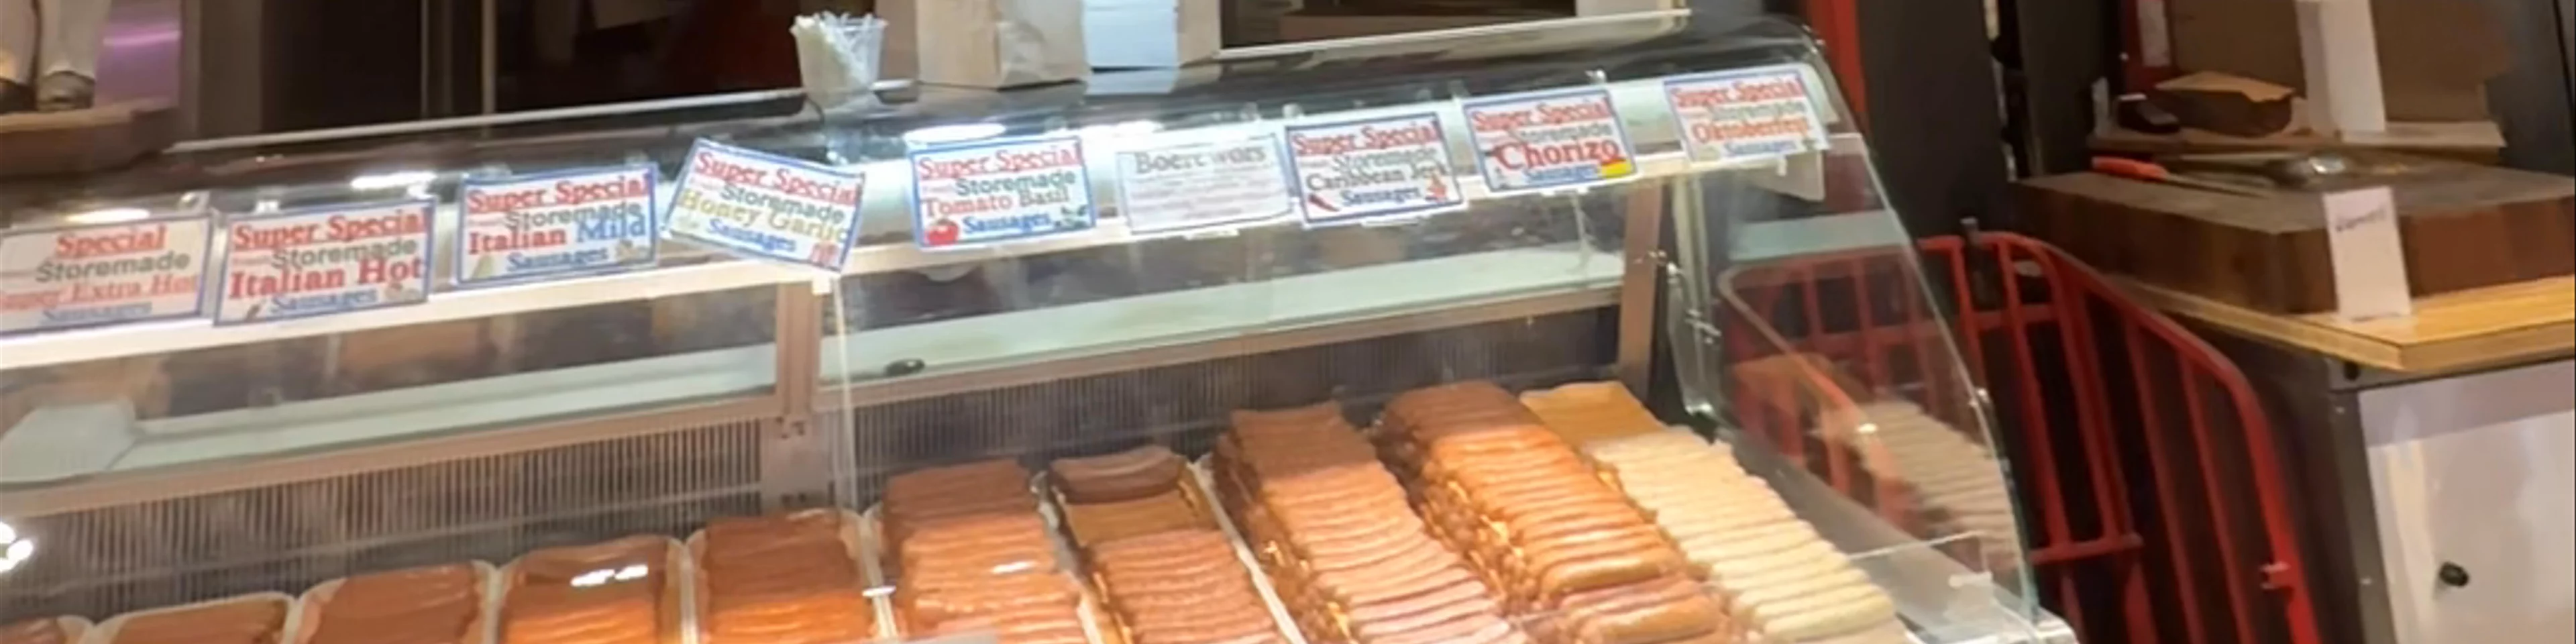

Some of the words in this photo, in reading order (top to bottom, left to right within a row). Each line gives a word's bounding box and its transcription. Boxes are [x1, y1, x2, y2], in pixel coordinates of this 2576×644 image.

[1670, 87, 1733, 109] Super
[1732, 72, 1805, 103] Special
[1470, 111, 1534, 133] Super
[1534, 97, 1611, 126] Special
[1292, 133, 1357, 156] Super
[1360, 120, 1442, 150] Special
[1487, 138, 1621, 170] Chorizo
[920, 156, 990, 180] Super
[996, 140, 1083, 172] Special
[468, 189, 547, 215] Super
[554, 172, 652, 205] Special
[694, 151, 767, 185] Super
[774, 168, 861, 206] Special
[954, 170, 1076, 197] Storemade
[1306, 168, 1406, 192] Caribbean
[506, 201, 642, 231] Storemade
[677, 187, 761, 227] Honey
[767, 207, 849, 241] Garlic
[720, 180, 845, 225] Storemade
[920, 196, 1012, 219] Tomato
[1017, 186, 1071, 207] Basil
[55, 223, 166, 258] Special
[233, 224, 319, 251] Super
[469, 228, 567, 256] Italian
[576, 213, 646, 243] Mild
[36, 250, 190, 282] Storemade
[271, 239, 417, 270] Storemade
[229, 268, 345, 299] Italian
[358, 258, 424, 284] Hot
